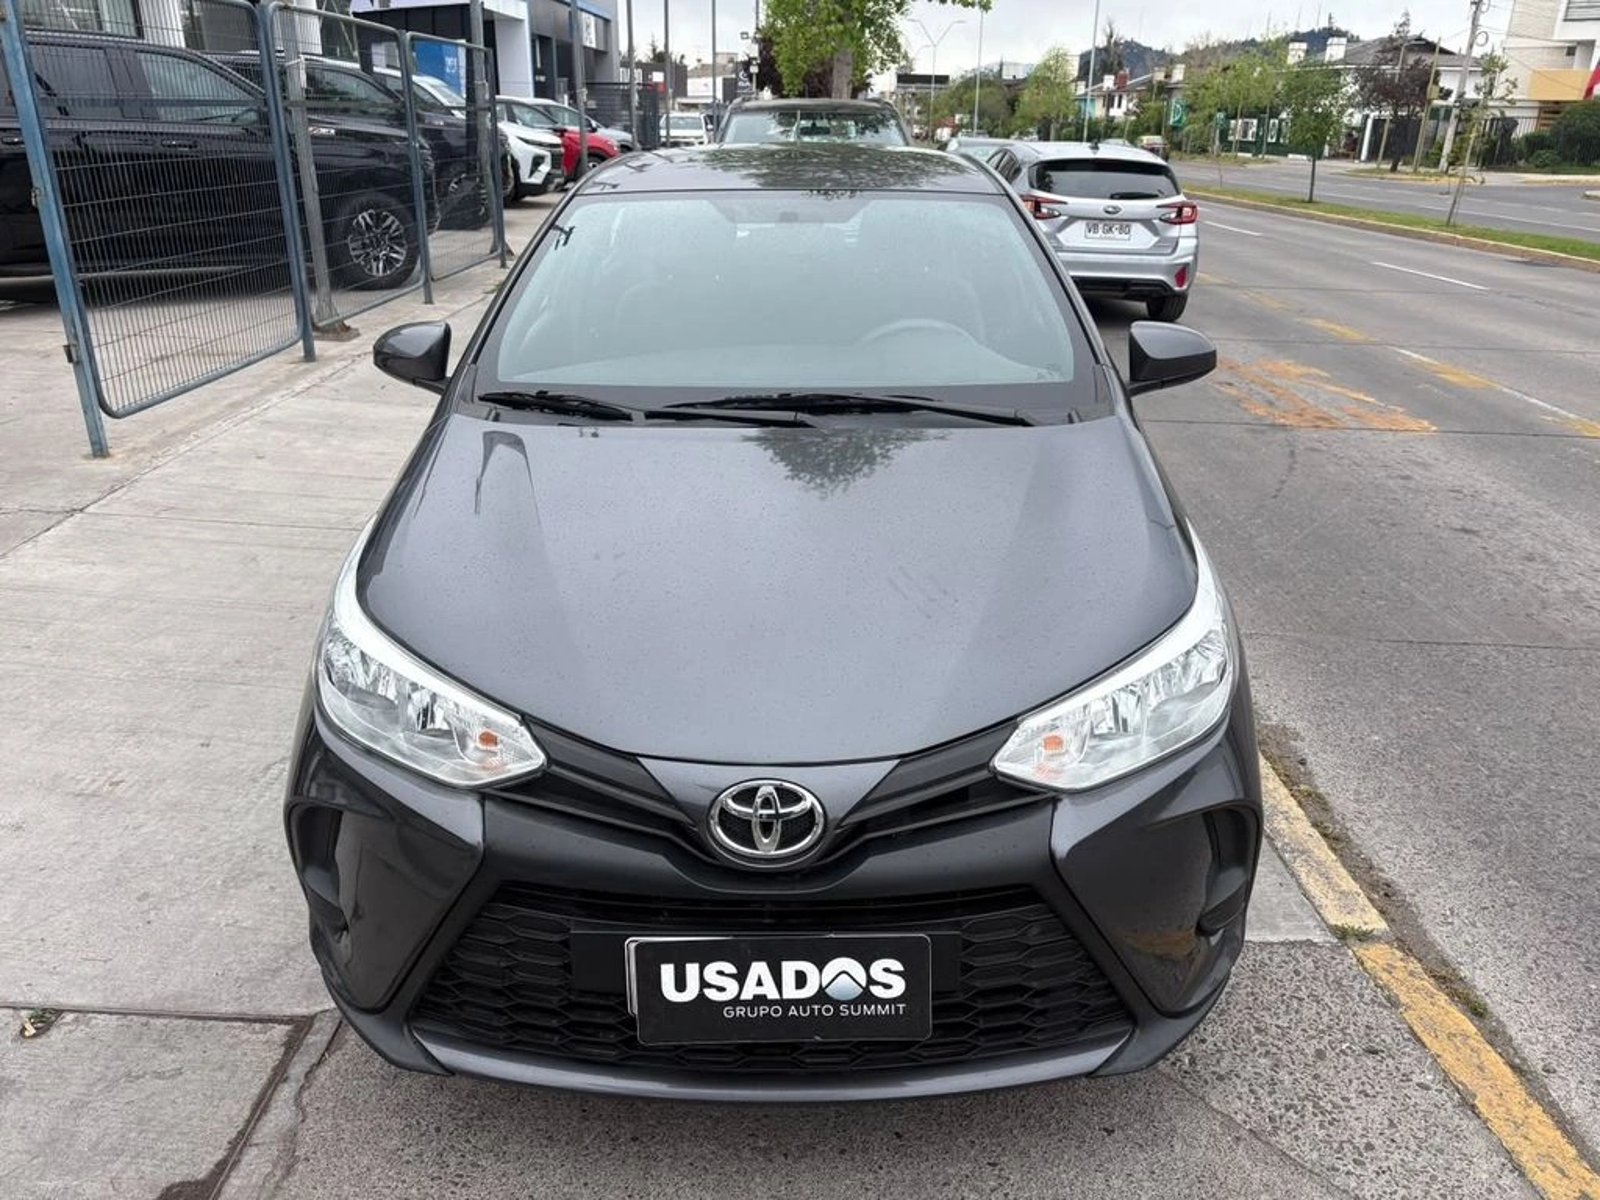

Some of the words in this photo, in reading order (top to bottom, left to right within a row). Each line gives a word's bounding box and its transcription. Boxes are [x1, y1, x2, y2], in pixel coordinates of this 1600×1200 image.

[660, 957, 906, 1002] USADOS
[723, 1005, 783, 1018] GRUPO
[788, 1004, 834, 1017] AUTO
[840, 1003, 906, 1016] SUMMIT
